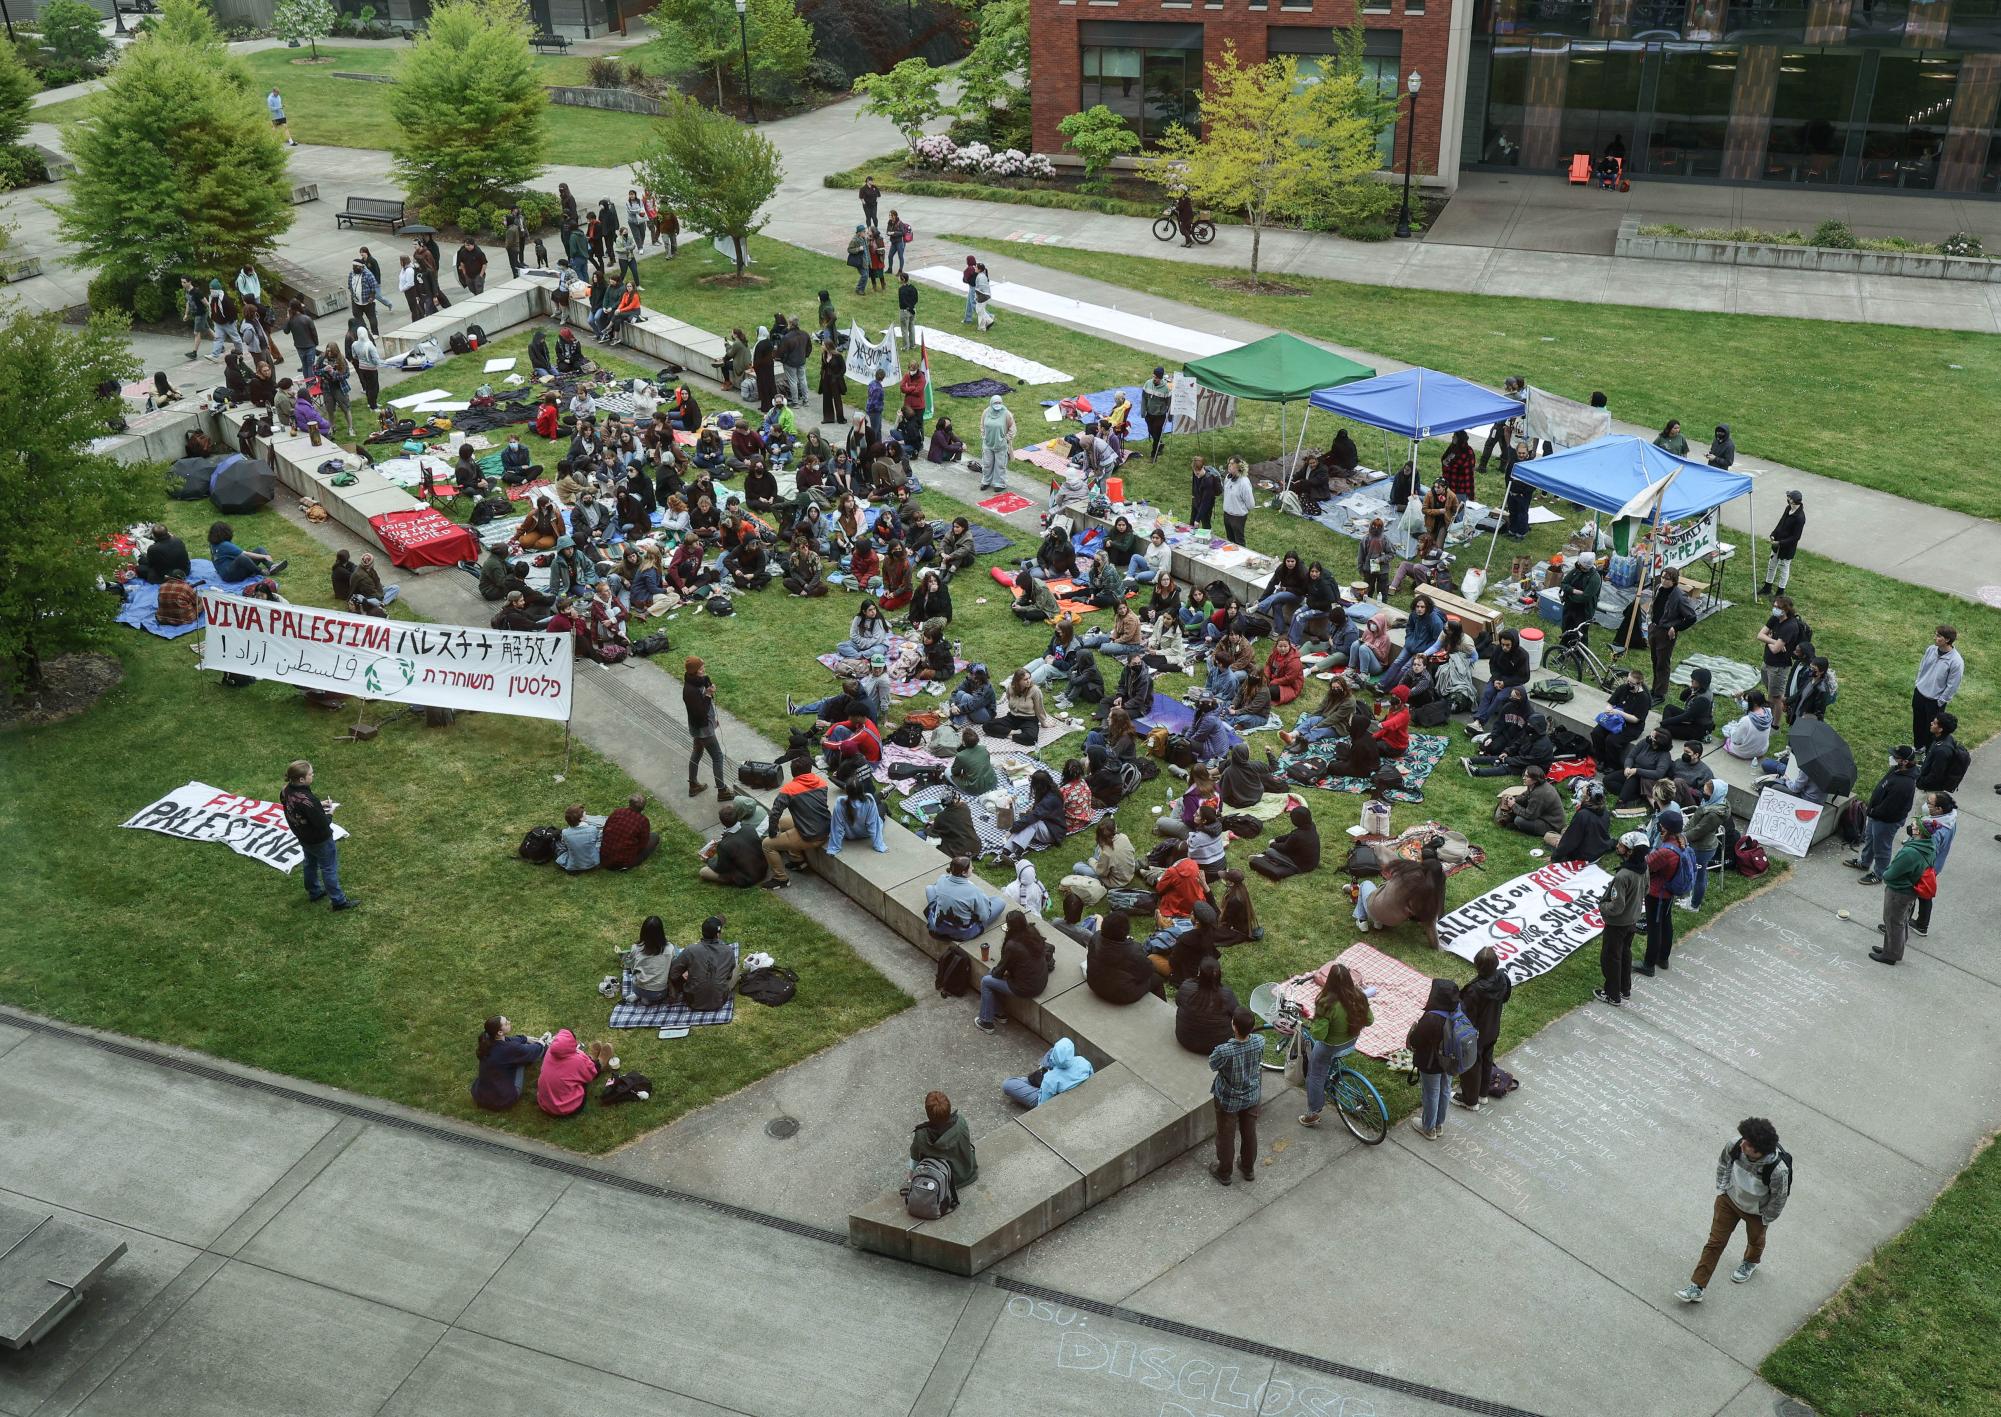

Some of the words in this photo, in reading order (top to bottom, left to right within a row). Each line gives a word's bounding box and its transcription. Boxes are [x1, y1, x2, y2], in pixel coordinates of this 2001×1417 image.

[203, 597, 264, 633] VIVA
[269, 609, 391, 651] PALESTINA
[397, 627, 493, 661] パレスチナ
[508, 674, 562, 698] פלסטין
[1758, 789, 1796, 816] FREE
[130, 801, 302, 864] PALESTINE
[1509, 883, 1533, 899] ON
[1540, 889, 1603, 929] SILENCE
[1572, 924, 1592, 936] IN
[1008, 1296, 1089, 1328] OSU:
